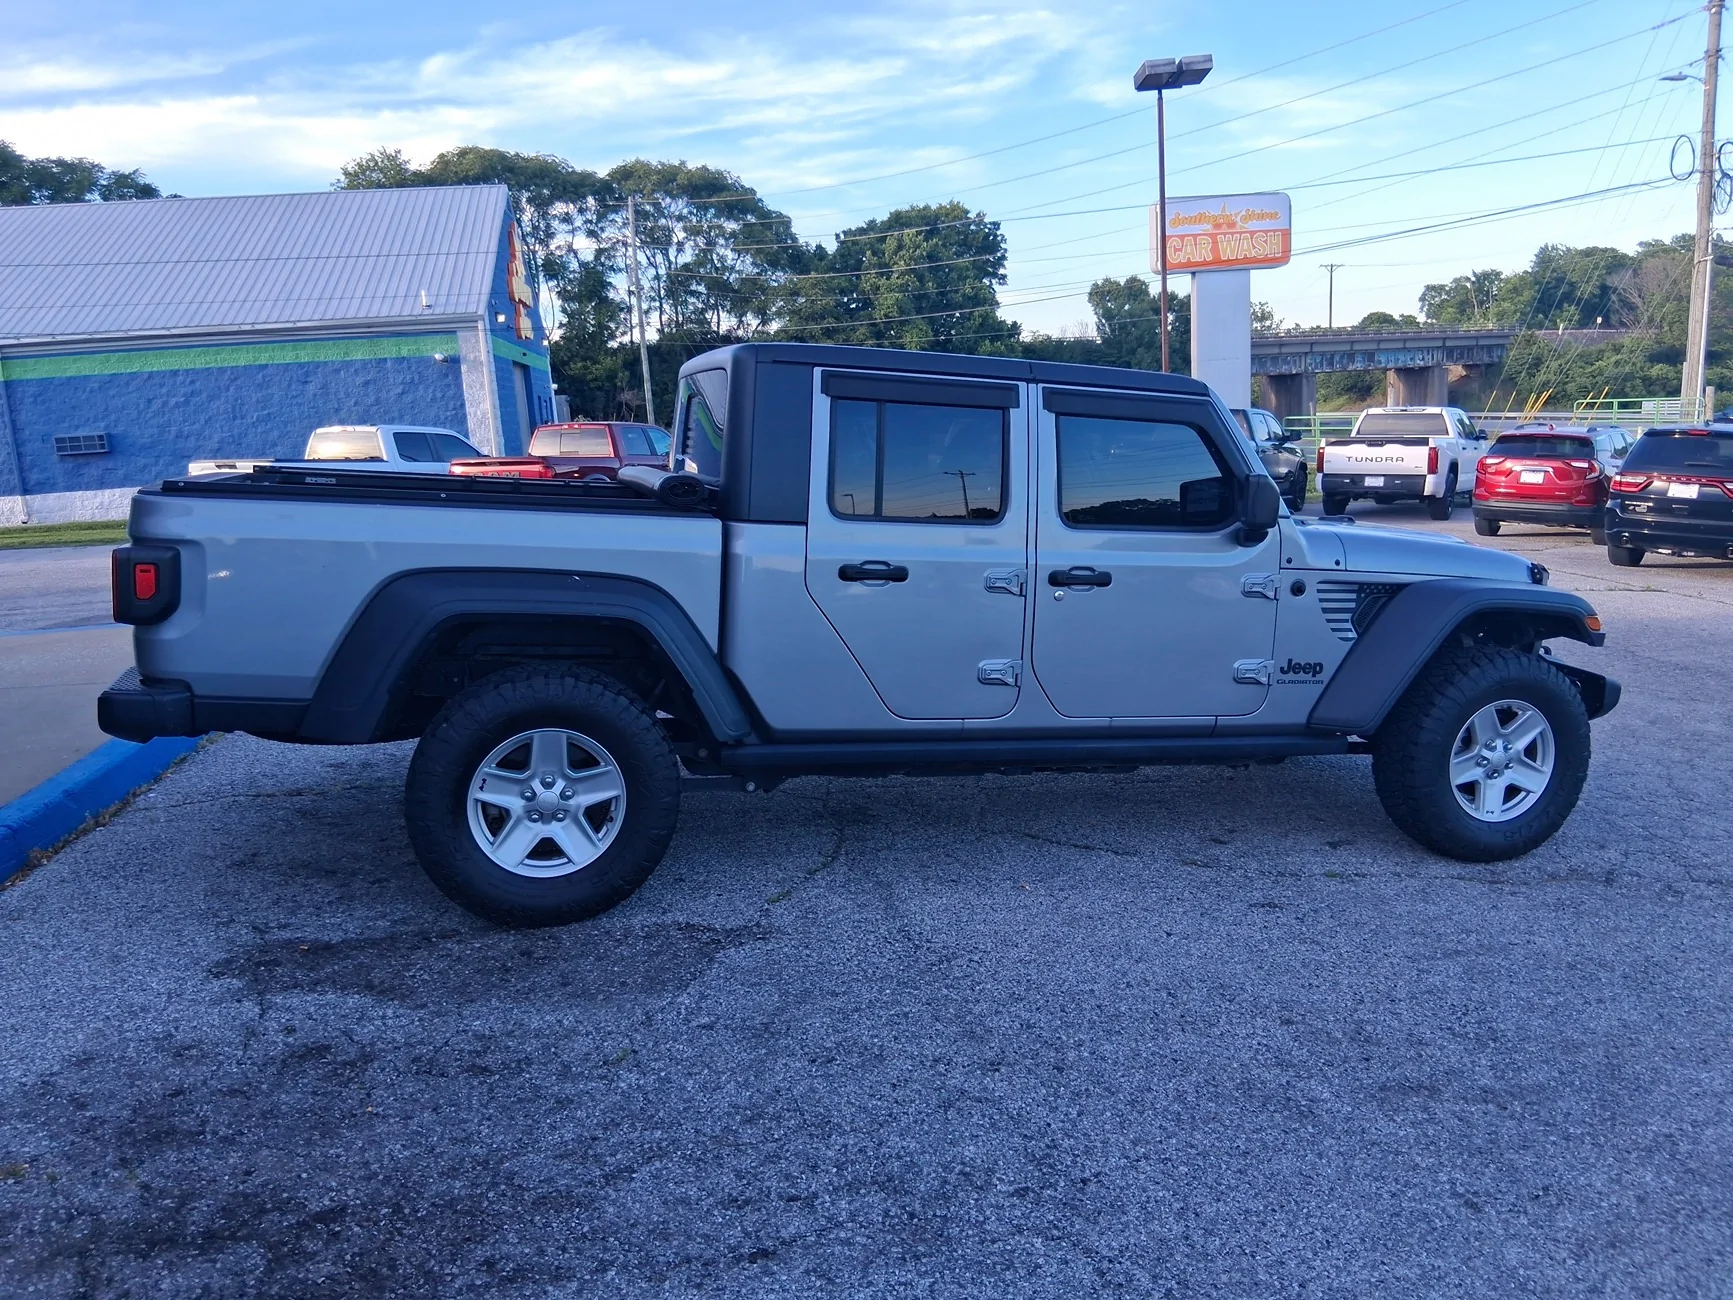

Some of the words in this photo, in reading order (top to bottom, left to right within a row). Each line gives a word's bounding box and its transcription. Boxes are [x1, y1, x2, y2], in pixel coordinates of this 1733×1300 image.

[1168, 211, 1236, 229] Southern
[1167, 235, 1213, 264] CAR
[1217, 232, 1282, 260] WASH
[1280, 658, 1324, 677] Jeep
